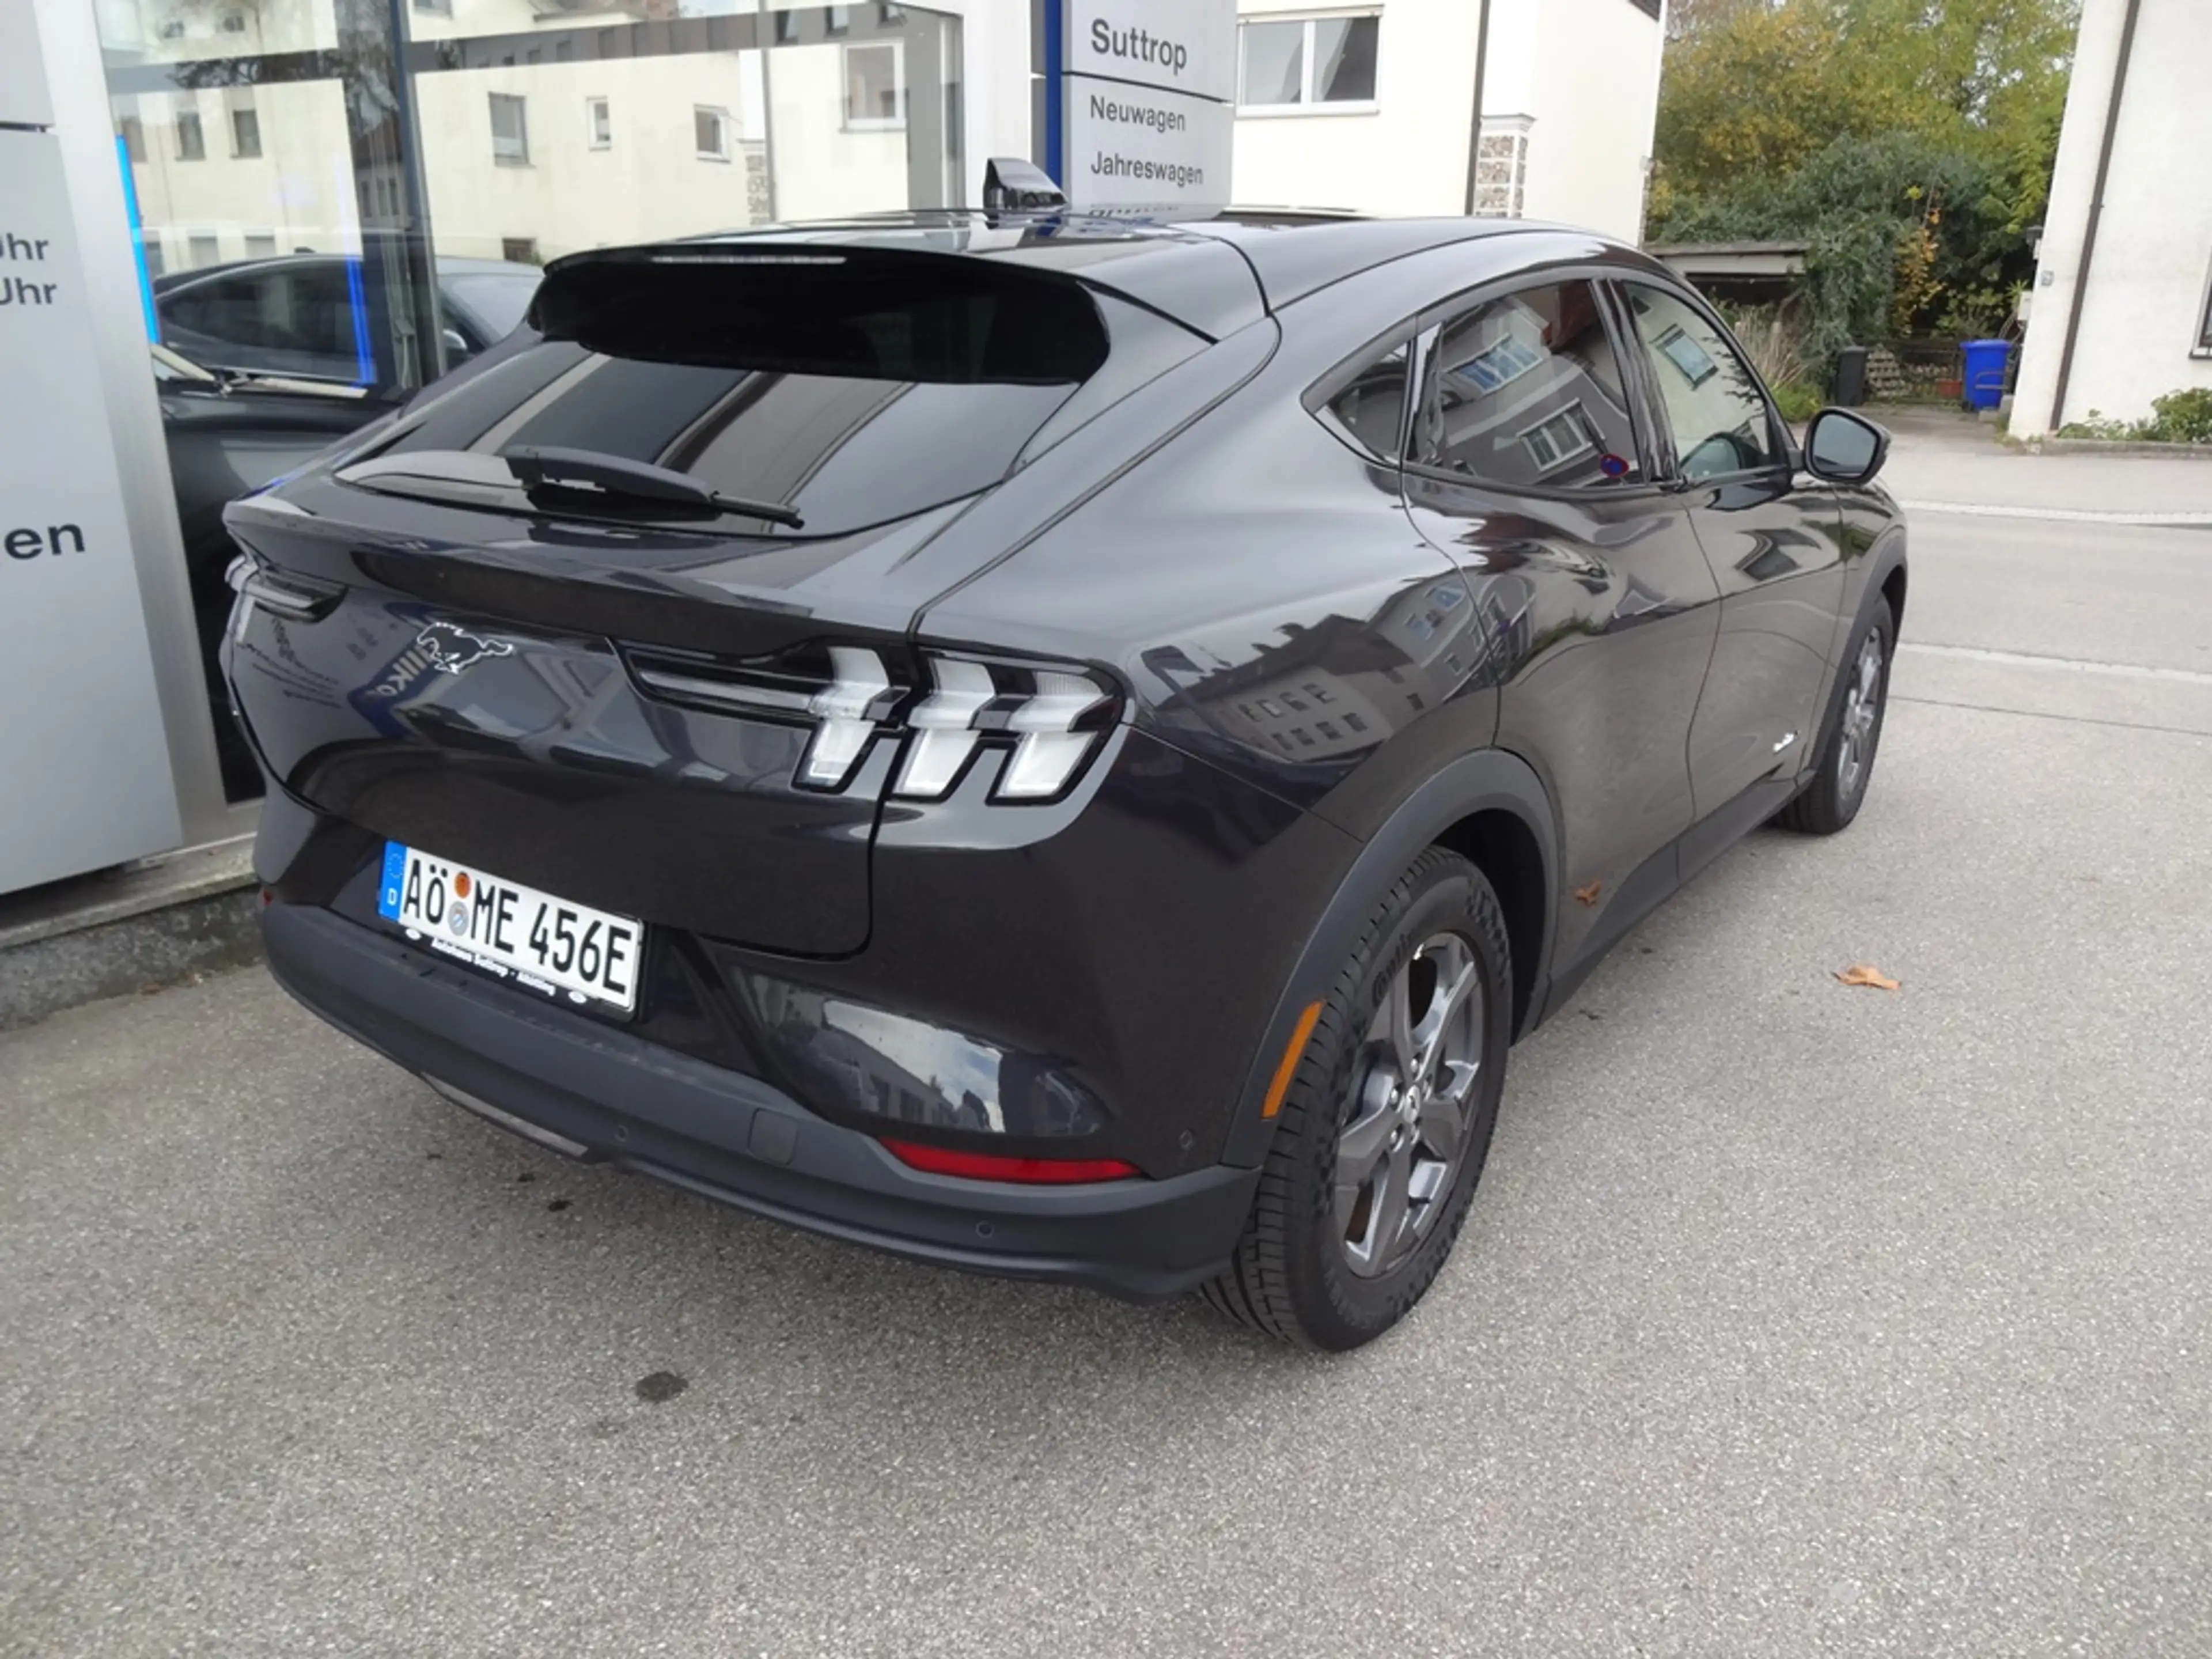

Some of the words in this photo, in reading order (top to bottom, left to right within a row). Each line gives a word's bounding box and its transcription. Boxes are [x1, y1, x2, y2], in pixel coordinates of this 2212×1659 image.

[1091, 18, 1187, 76] Suttrop
[1090, 94, 1185, 133] Neuwagen
[1090, 151, 1203, 187] Jahreswagen
[0, 233, 48, 260] hr
[387, 887, 398, 905] D
[403, 859, 448, 925] AÖ
[471, 880, 520, 954] ME
[529, 902, 632, 994] 456E
